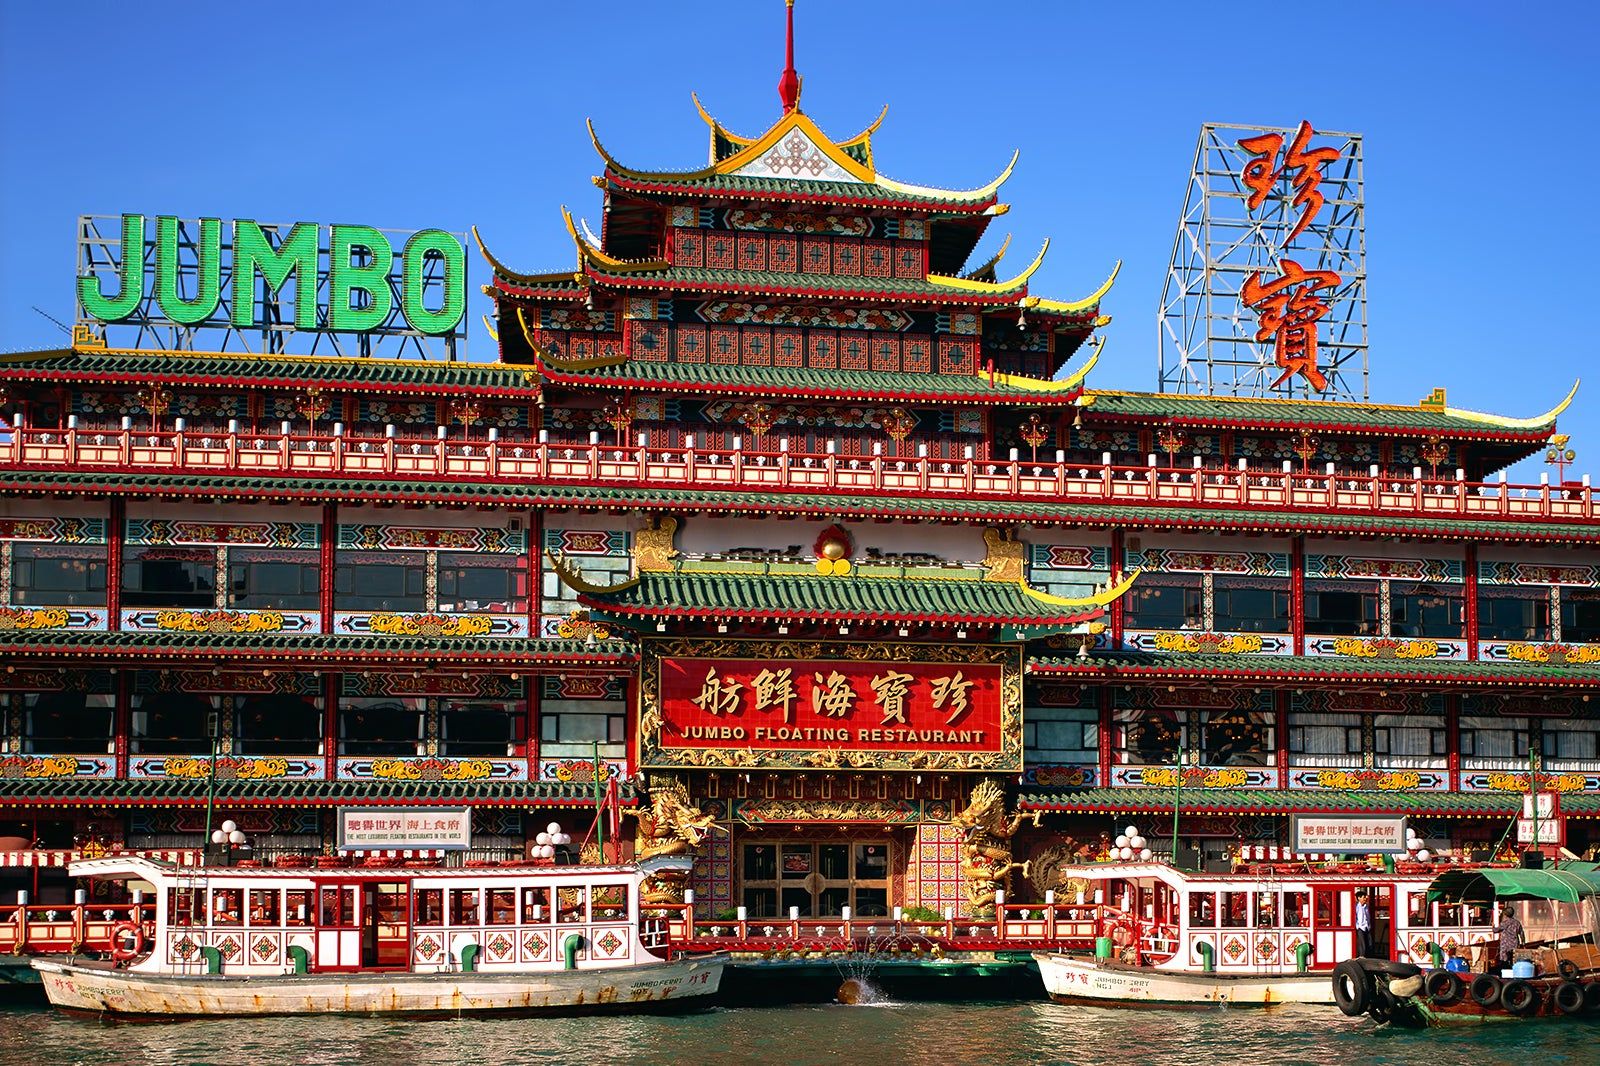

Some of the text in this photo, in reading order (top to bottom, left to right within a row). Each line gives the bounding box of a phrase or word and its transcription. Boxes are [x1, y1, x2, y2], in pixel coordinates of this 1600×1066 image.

[75, 213, 466, 335] JUMBO
[680, 725, 985, 744] JUMBO FLOATING RESTAURANT
